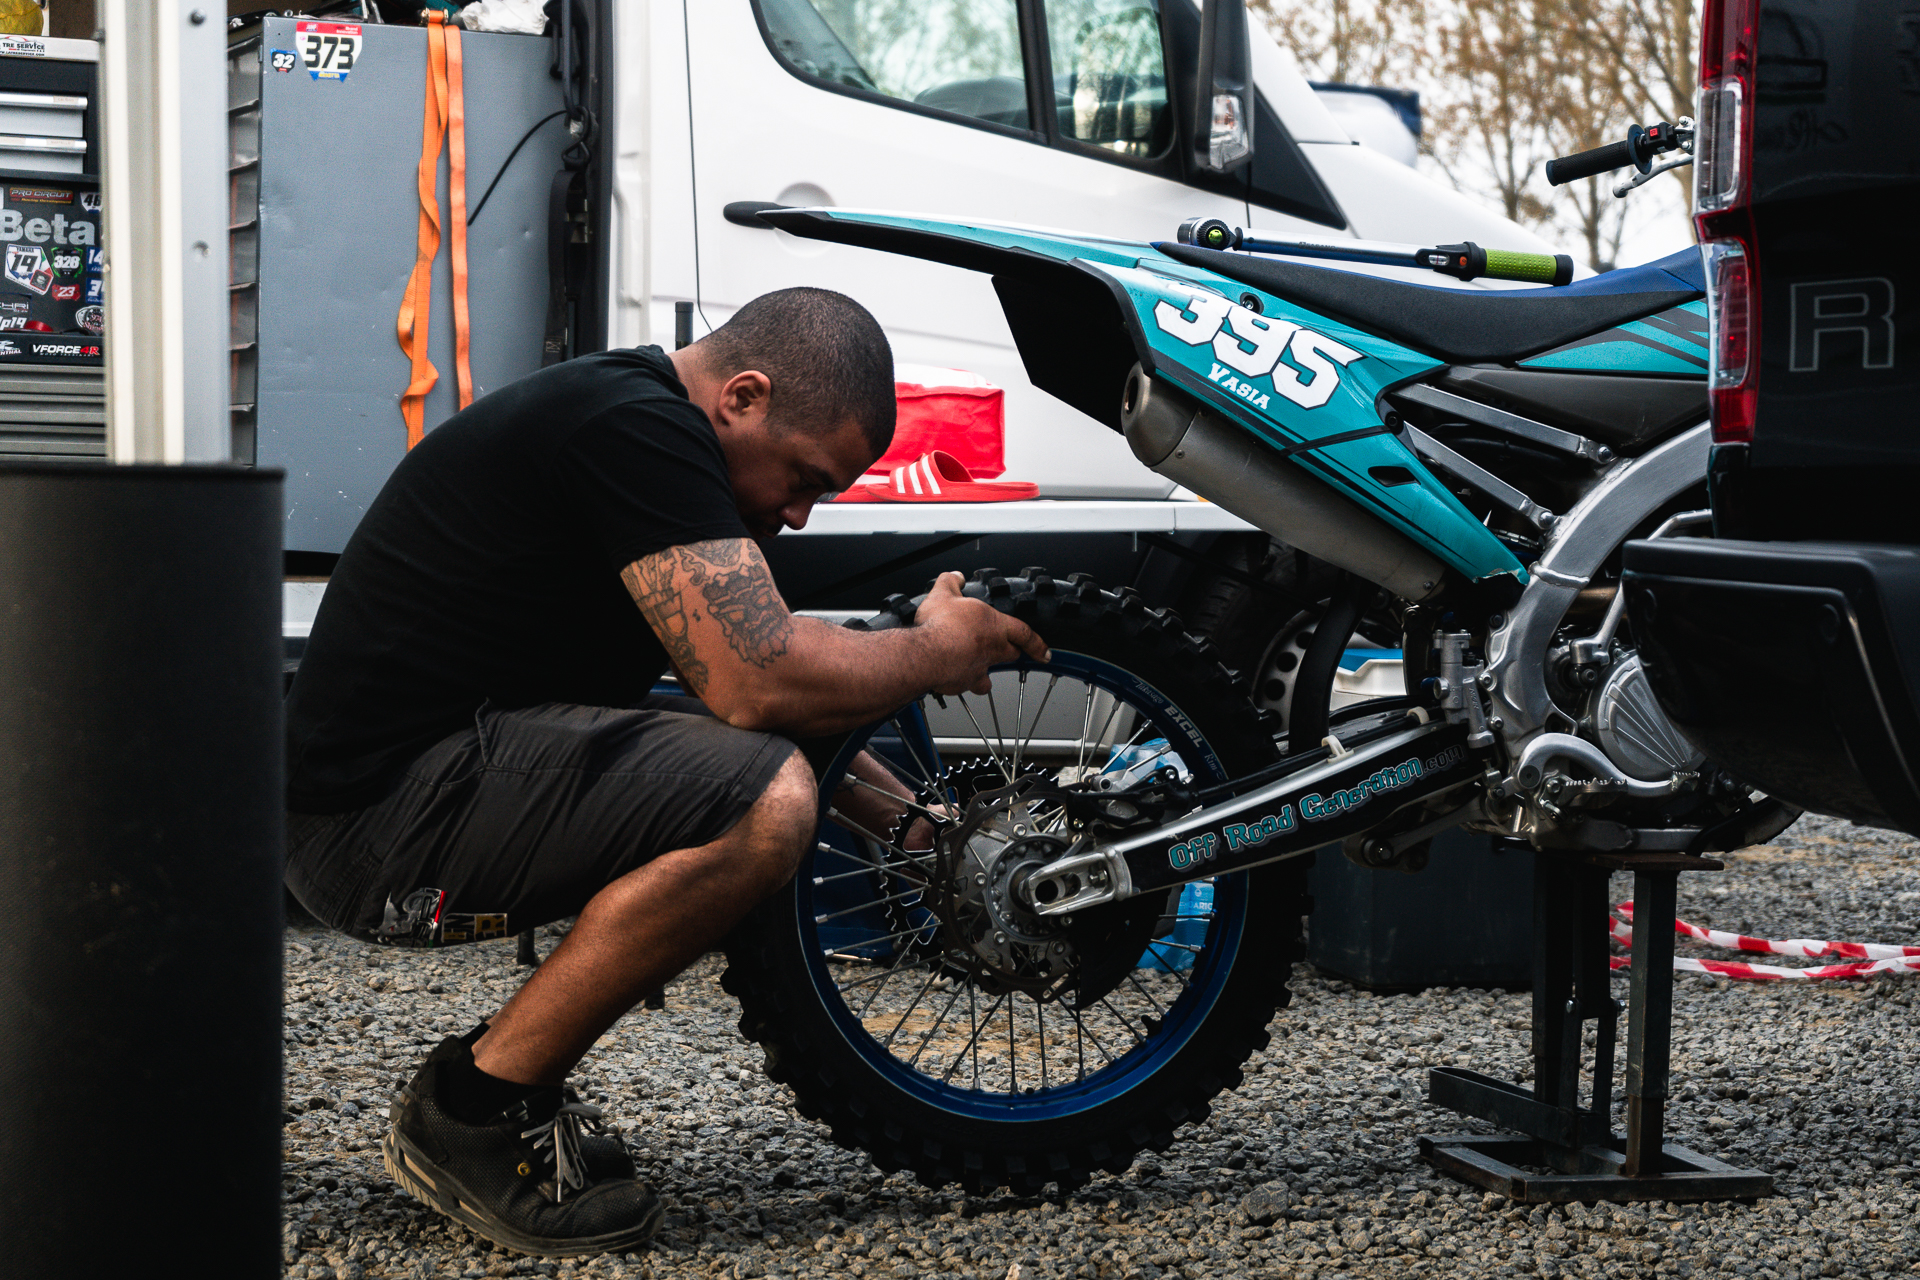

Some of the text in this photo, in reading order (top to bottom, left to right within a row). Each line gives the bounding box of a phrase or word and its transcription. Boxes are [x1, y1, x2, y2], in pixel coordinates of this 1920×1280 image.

[273, 53, 295, 69] 32
[304, 34, 355, 70] 373
[11, 189, 72, 198] PRO CIRCUIT
[0, 208, 96, 246] Beta
[11, 253, 39, 273] 19
[53, 255, 80, 269] 328
[57, 286, 76, 297] 23
[1789, 277, 1894, 372] R
[32, 344, 100, 356] VFORCE4R
[1153, 283, 1367, 411] 395
[1208, 362, 1271, 410] YASIA
[1164, 704, 1204, 748] EXCEL
[1168, 831, 1217, 870] Off
[1222, 803, 1295, 851] Road
